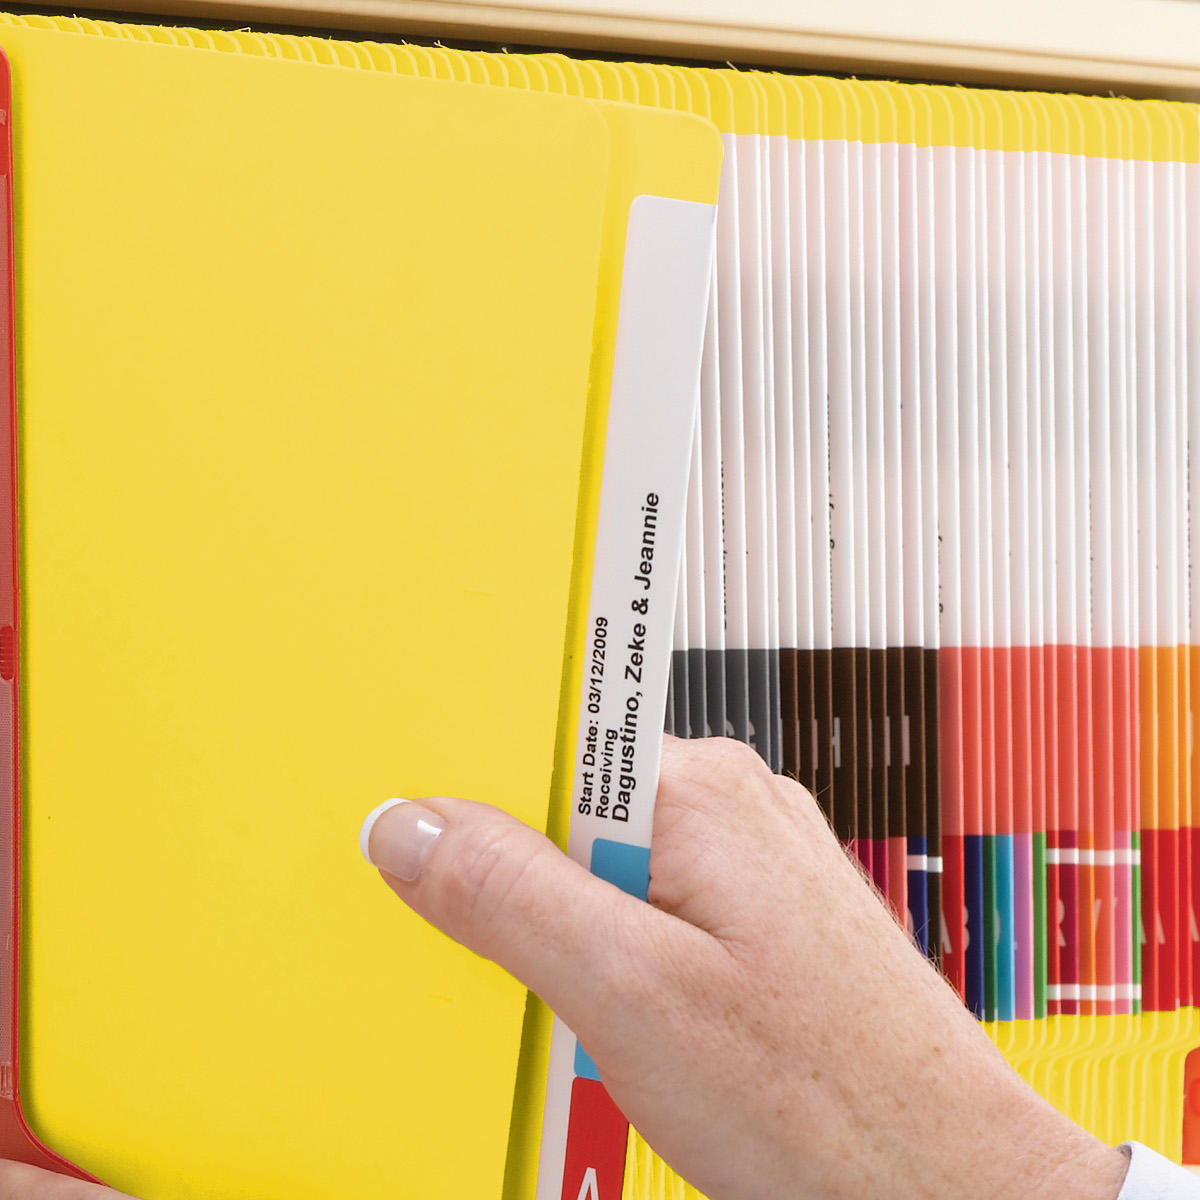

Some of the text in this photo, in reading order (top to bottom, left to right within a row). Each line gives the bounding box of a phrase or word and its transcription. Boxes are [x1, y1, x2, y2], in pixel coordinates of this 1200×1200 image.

[579, 617, 607, 815] Start Date: 03/12/2009
[610, 493, 658, 822] Dagustino, Zeke & Jeannie
[593, 727, 621, 820] Receiving
